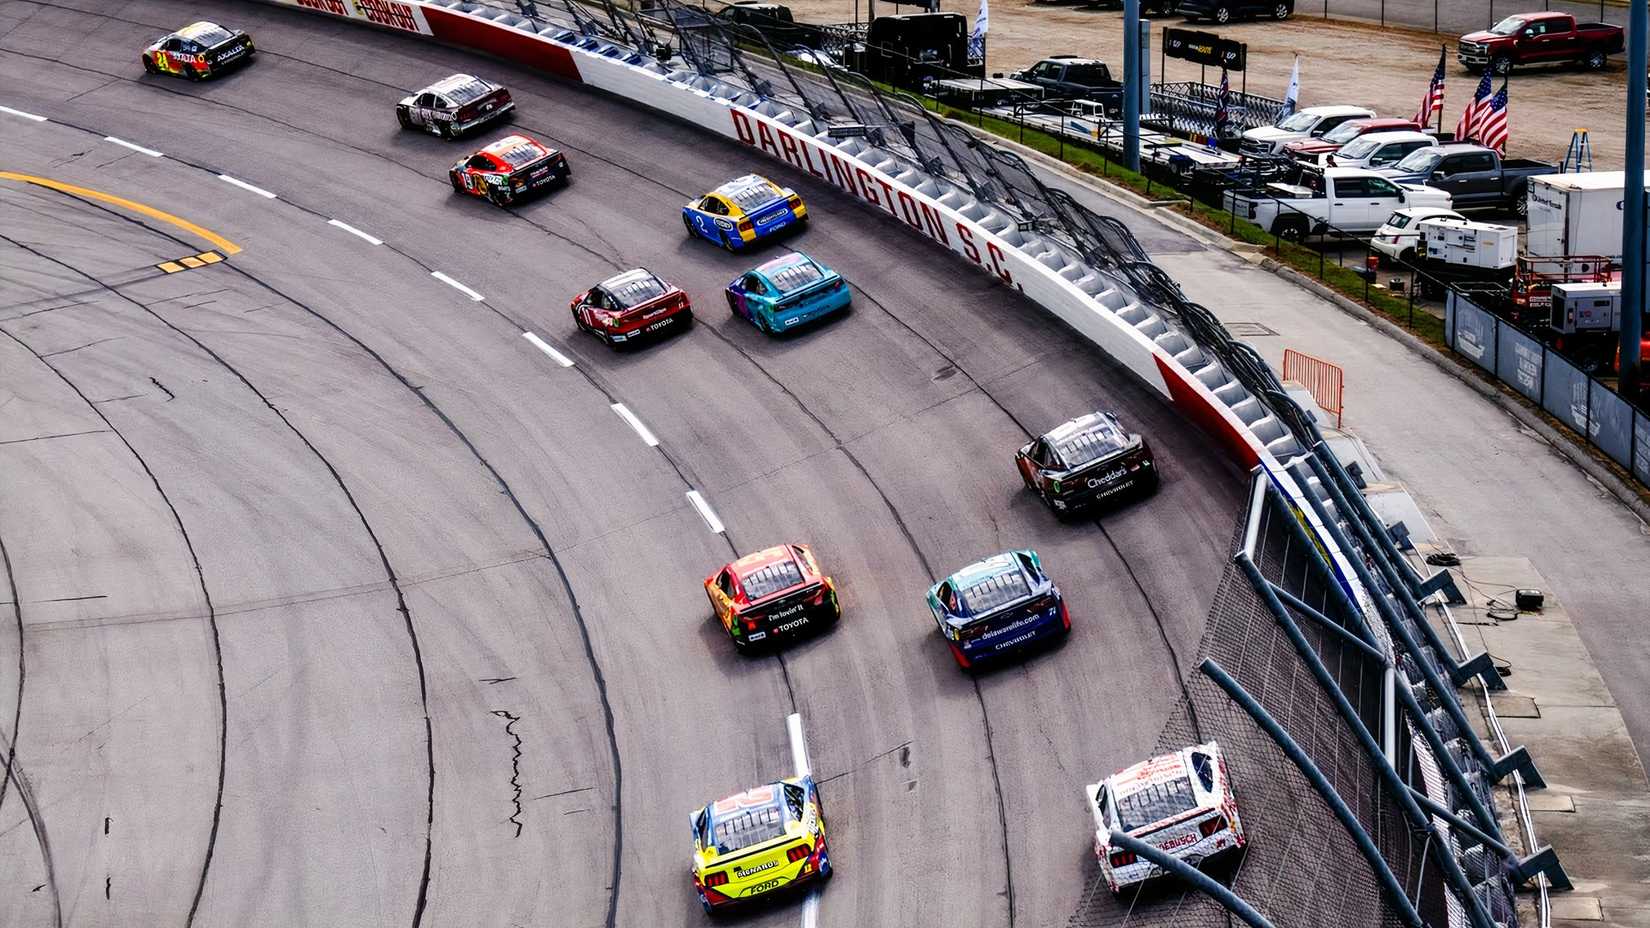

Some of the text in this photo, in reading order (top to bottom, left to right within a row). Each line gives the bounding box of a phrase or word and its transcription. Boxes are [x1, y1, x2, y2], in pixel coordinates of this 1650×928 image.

[217, 44, 245, 62] AXALTA
[536, 175, 556, 186] TOYOTA
[729, 108, 950, 245] DARLINGTON
[695, 215, 708, 233] 2
[650, 317, 674, 331] TOYOTA
[1088, 465, 1128, 488] Cheddar's
[778, 616, 809, 632] TOYOTA
[981, 613, 1040, 640] delawarelife.com
[750, 880, 779, 895] FORD
